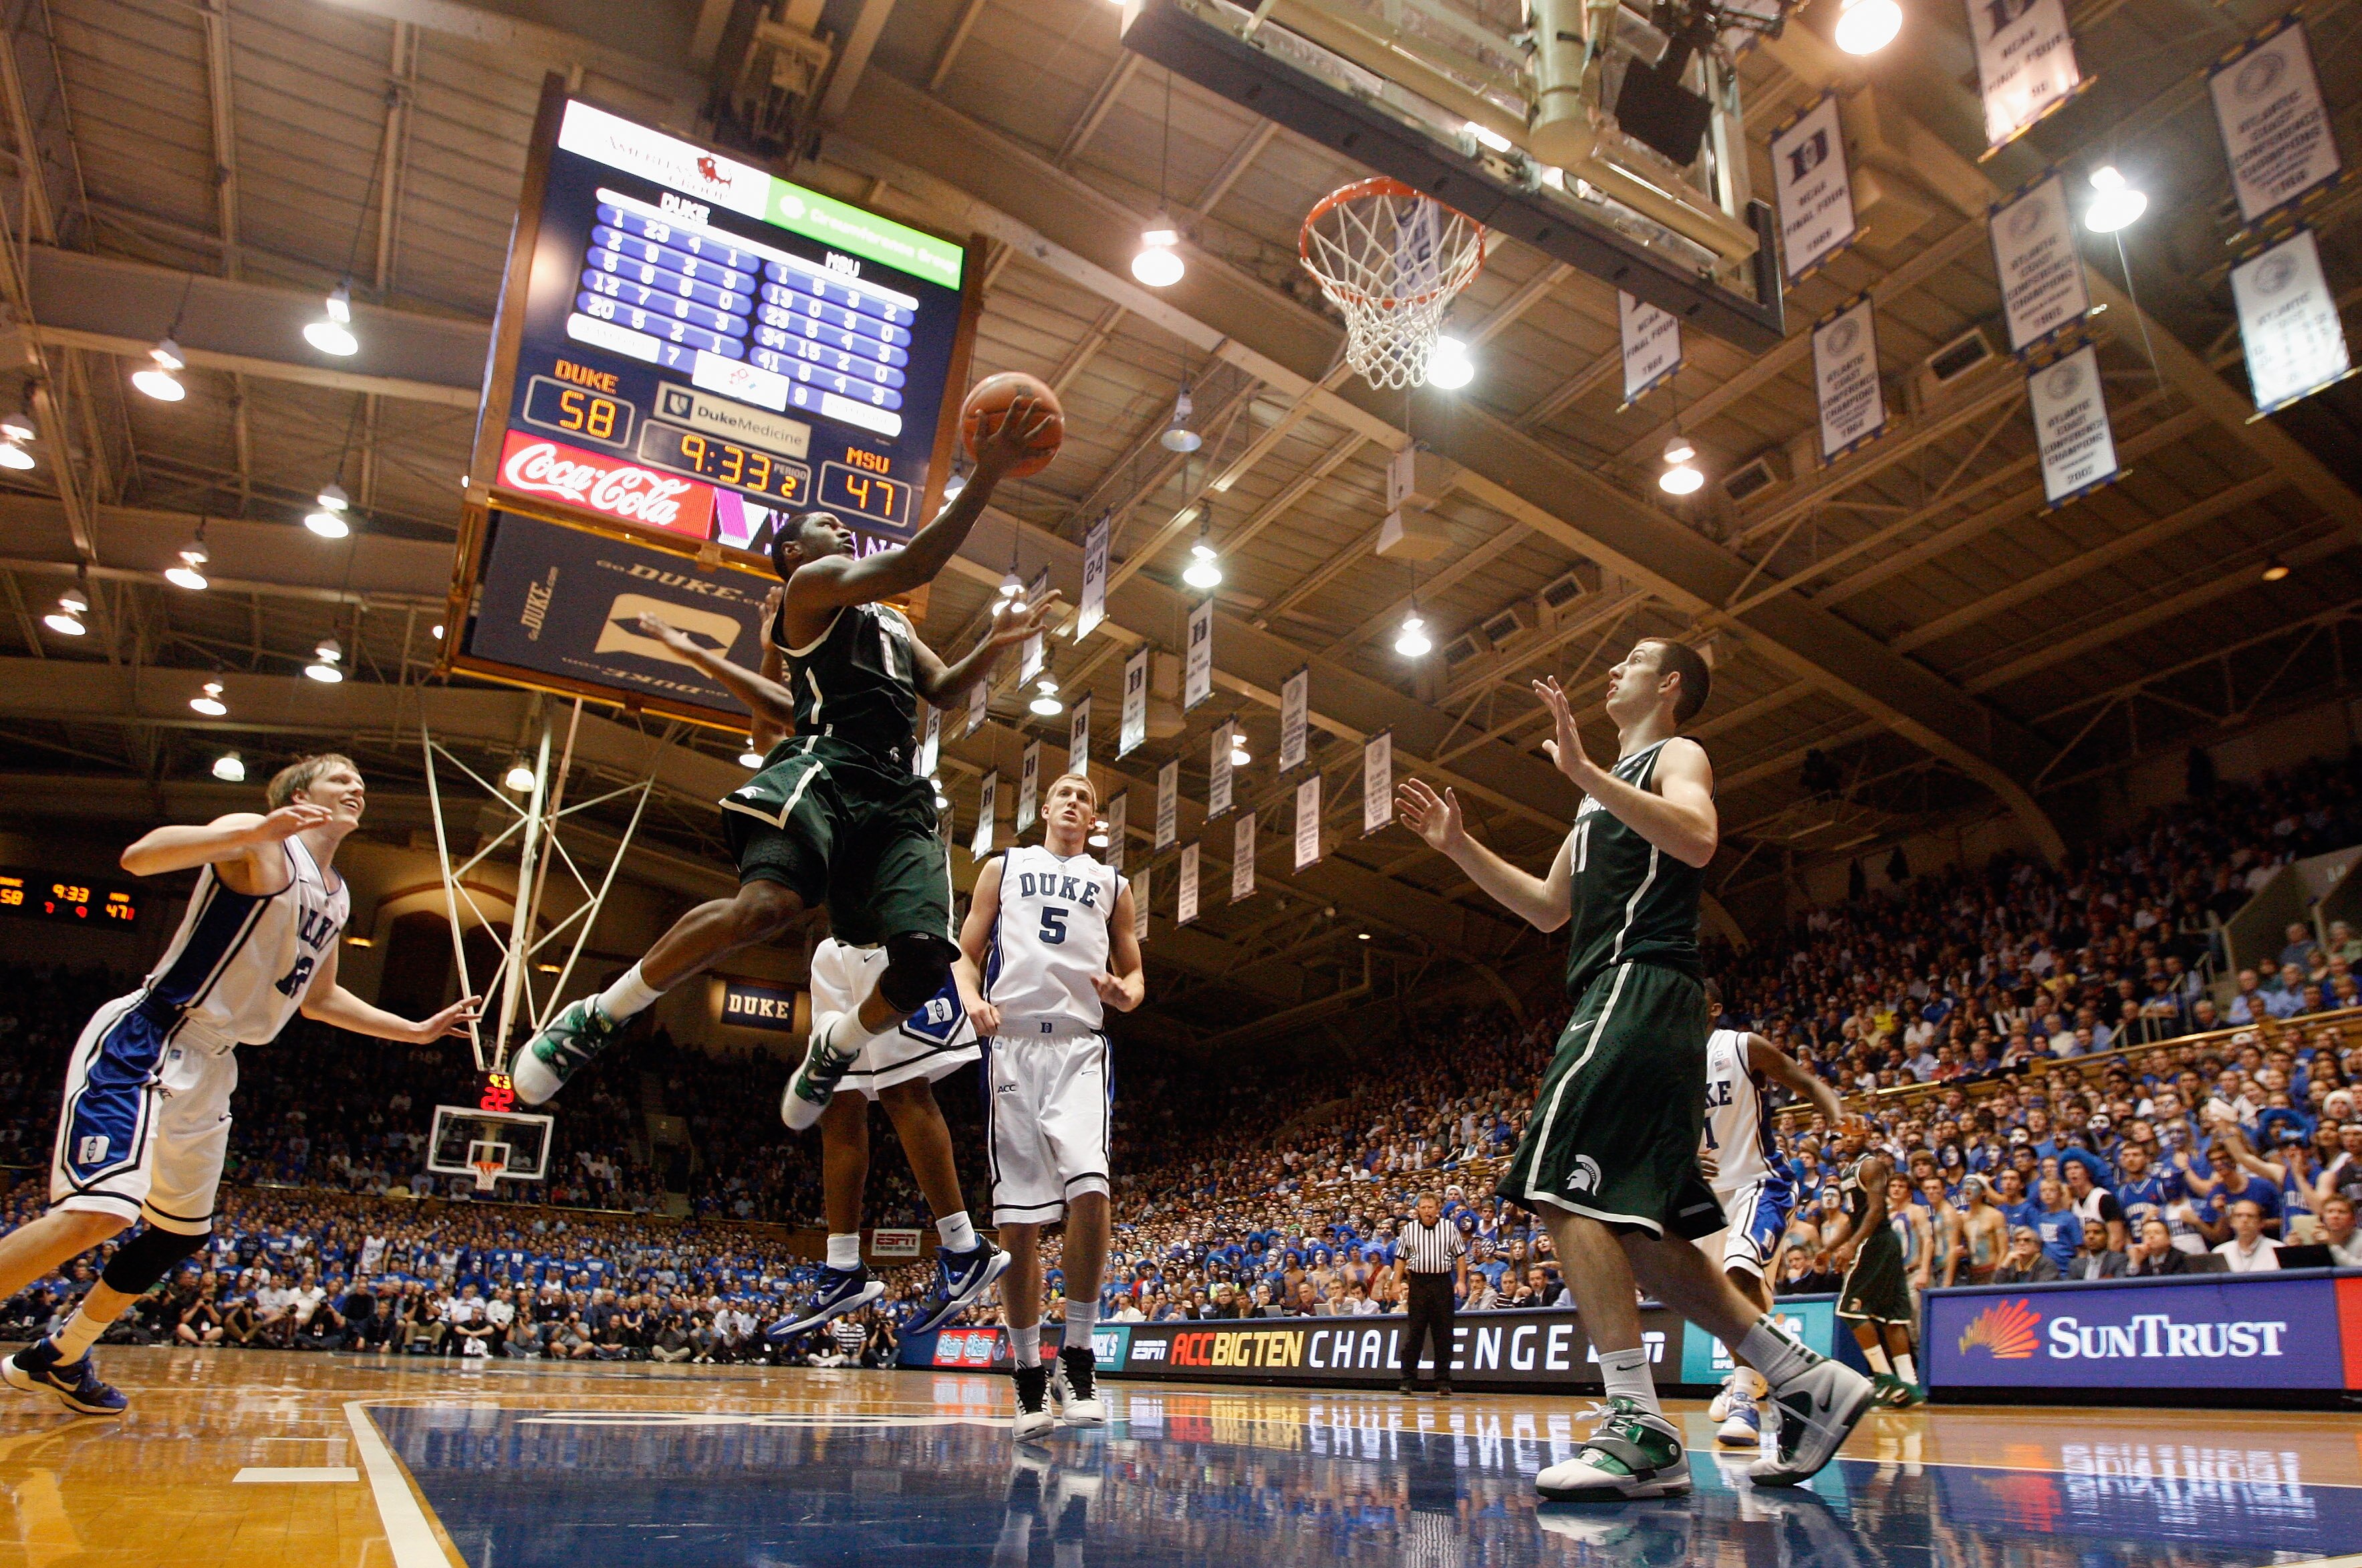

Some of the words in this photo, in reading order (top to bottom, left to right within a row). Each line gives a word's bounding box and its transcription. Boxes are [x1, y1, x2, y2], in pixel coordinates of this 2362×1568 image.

[660, 192, 710, 225] DUKE
[607, 232, 623, 252] 2
[683, 257, 698, 277] 2
[728, 249, 737, 267] 1
[825, 251, 860, 277] MSU
[594, 273, 620, 297] 12
[638, 286, 651, 305] 7
[719, 291, 733, 310] 0
[778, 267, 787, 284] 1
[884, 303, 897, 321] 2
[587, 296, 616, 319] 20
[670, 322, 685, 342] 2
[712, 336, 721, 354] 1
[809, 300, 822, 318] 0
[881, 324, 894, 342] 0
[668, 346, 680, 365] 7
[837, 352, 850, 372] 2
[555, 359, 619, 394] DUKE
[559, 390, 616, 438] 58
[681, 434, 771, 491] 9:33
[774, 463, 807, 481] PERIOD
[846, 446, 890, 474] MSU
[505, 443, 691, 525] Coca-Cola
[781, 476, 797, 497] 2
[846, 475, 894, 516] 47
[1086, 551, 1103, 585] 24
[0, 888, 24, 906] 58
[52, 884, 90, 902] 9:33
[1019, 873, 1100, 908] DUKE
[106, 904, 128, 920] 47
[1038, 906, 1069, 944] 5
[728, 994, 789, 1020] DUKE
[481, 1086, 514, 1112] 22
[997, 1084, 1017, 1093] ACC
[876, 1233, 916, 1245] ESPN
[1131, 1339, 1167, 1359] ESPN
